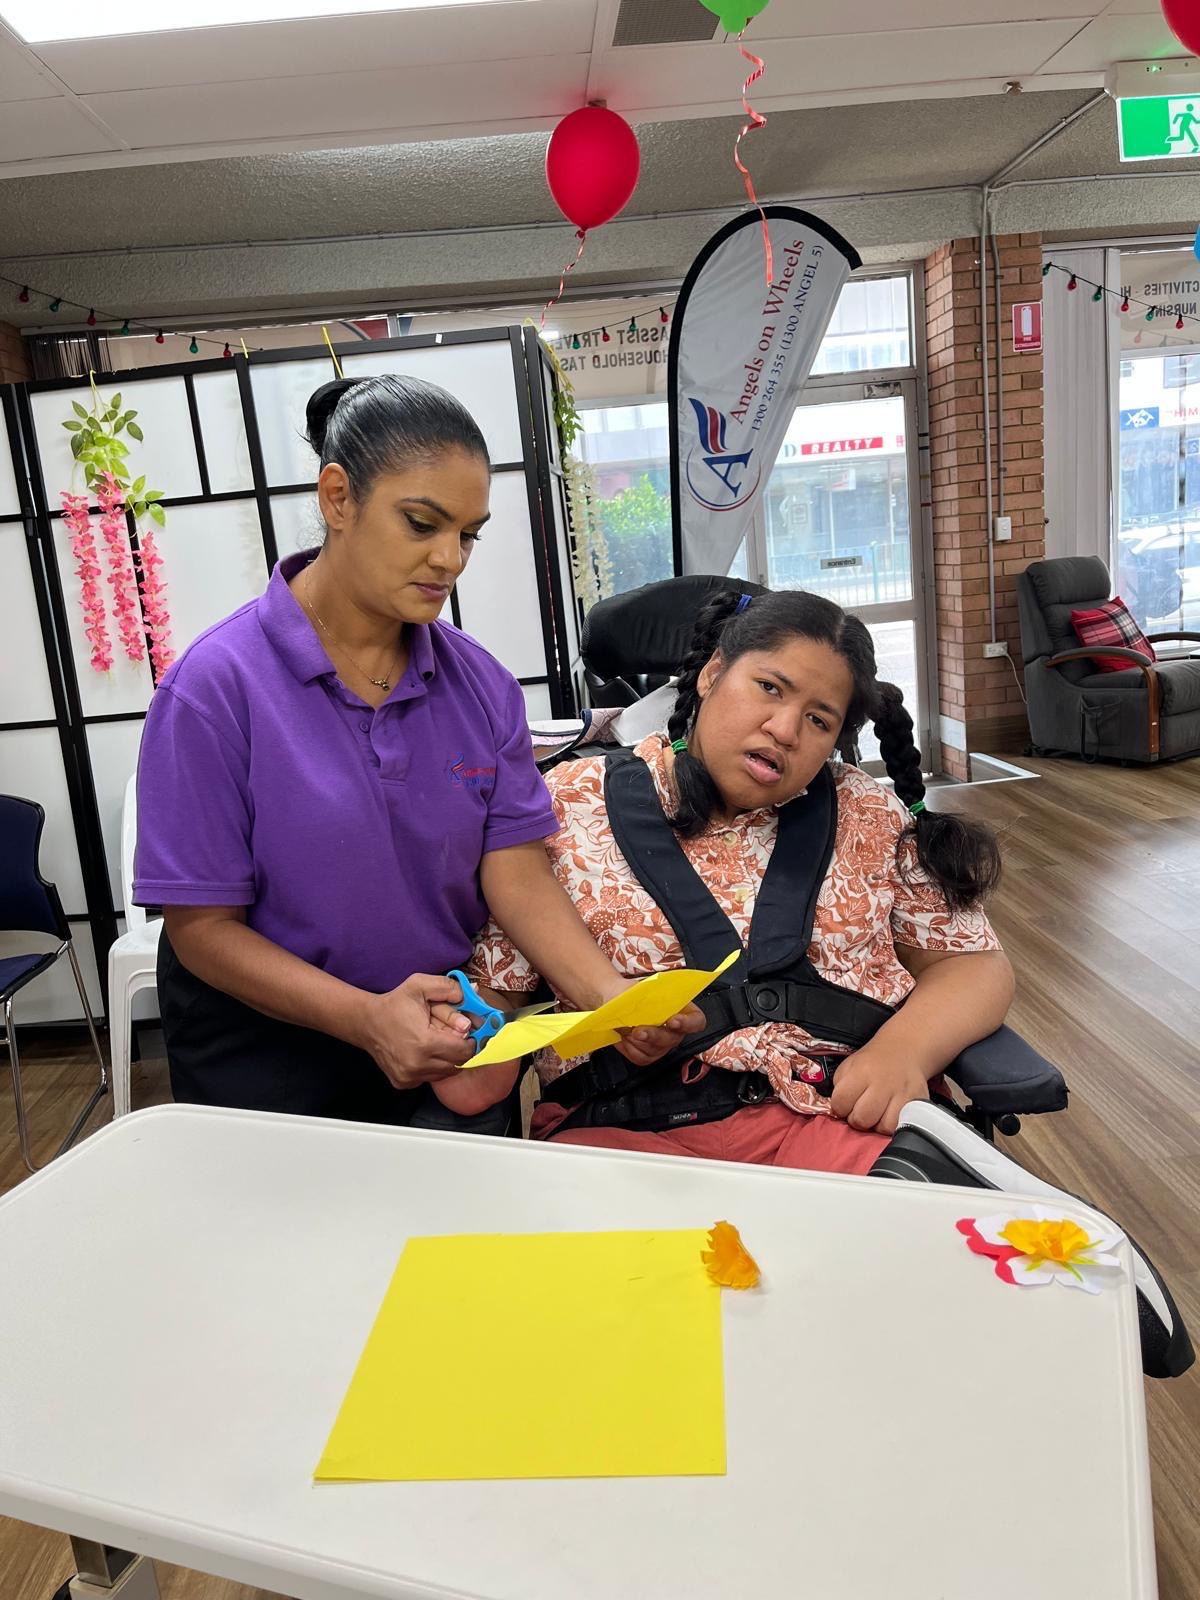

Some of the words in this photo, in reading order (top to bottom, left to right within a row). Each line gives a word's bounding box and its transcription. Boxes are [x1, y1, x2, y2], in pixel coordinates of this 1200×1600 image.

[762, 239, 805, 315] Wheels
[752, 404, 768, 431] 1300
[762, 379, 778, 401] 264
[770, 353, 786, 378] 355
[779, 315, 800, 350] (1300
[793, 261, 819, 313] ANGEL
[812, 245, 824, 258] 5)
[758, 325, 776, 351] on
[730, 357, 764, 424] Angels
[811, 438, 873, 455] REALTY
